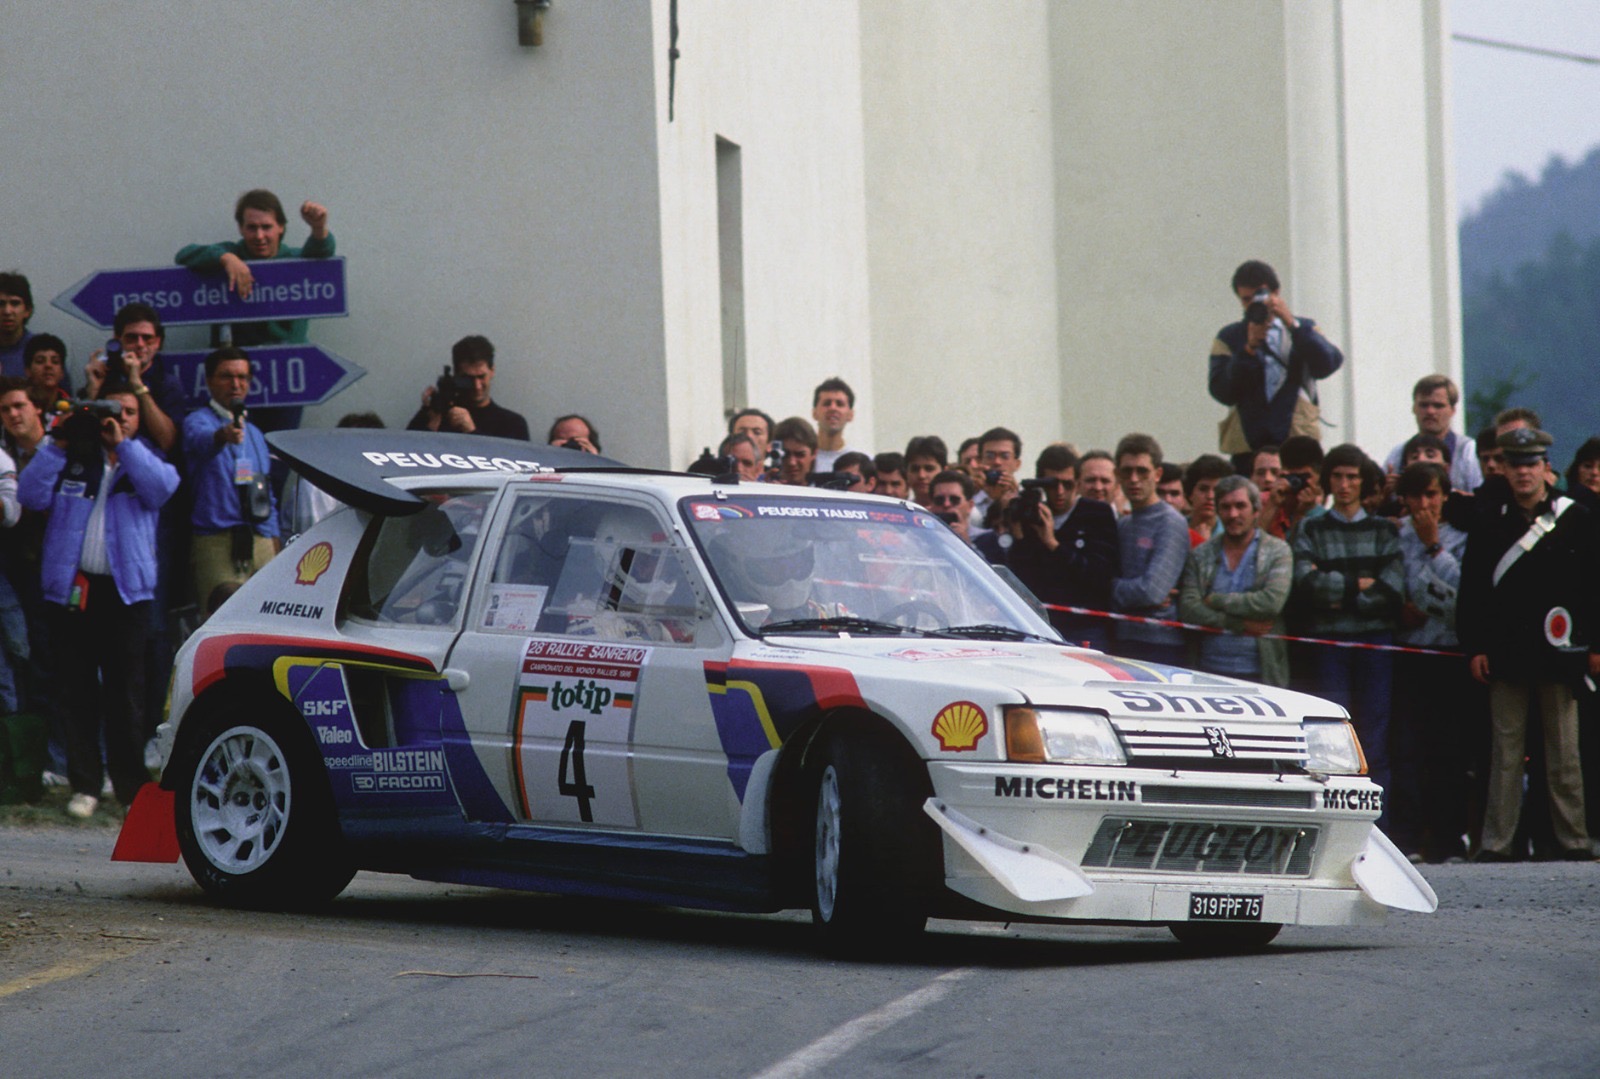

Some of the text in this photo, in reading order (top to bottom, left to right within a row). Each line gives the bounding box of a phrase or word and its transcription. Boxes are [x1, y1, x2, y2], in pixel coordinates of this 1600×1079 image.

[113, 290, 183, 315] passo
[193, 284, 229, 306] del
[362, 451, 541, 473] PEUGEOT
[758, 506, 819, 518] PEUGEOT
[820, 508, 869, 520] TALBOT
[260, 600, 324, 620] MICHELIN
[545, 642, 589, 658] RALLYE
[589, 646, 645, 663] SANREMO
[564, 665, 574, 673] DEL
[576, 666, 595, 674] MONDO
[596, 668, 618, 677] RALLIES
[552, 679, 611, 715] totip
[1108, 690, 1287, 718] Shell
[303, 700, 347, 716] SKF
[317, 725, 352, 744] Valeo
[324, 754, 373, 769] speedline
[373, 751, 444, 772] BILSTEIN
[558, 720, 595, 822] 4
[378, 776, 442, 788] FACOM
[995, 777, 1135, 802] MICHELIN
[1111, 821, 1295, 864] PEUGEOT
[1244, 898, 1260, 917] 75
